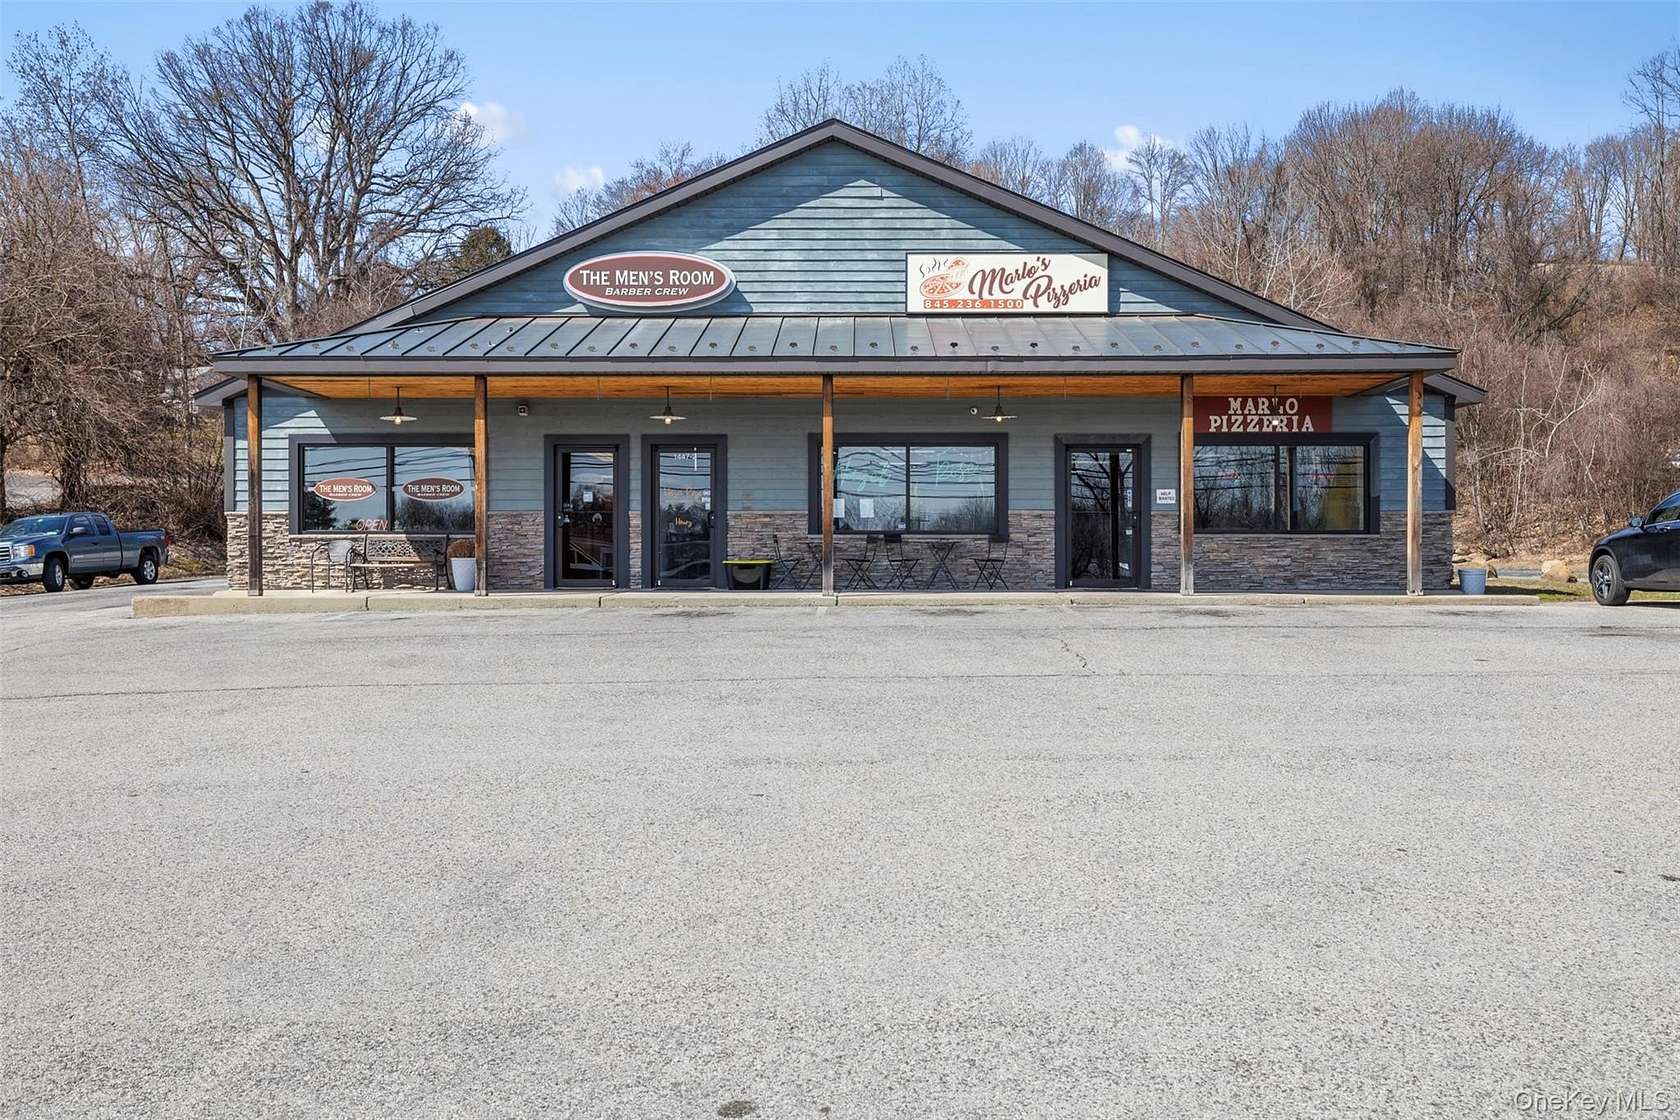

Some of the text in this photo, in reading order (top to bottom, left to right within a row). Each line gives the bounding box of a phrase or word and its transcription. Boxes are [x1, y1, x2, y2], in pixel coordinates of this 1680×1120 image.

[580, 270, 714, 285] THE MEN'S ROOM
[968, 256, 1051, 299] Marlo's
[605, 288, 689, 296] BARBER CREW
[1022, 273, 1101, 308] Pizzeria
[1209, 415, 1314, 432] PIZZERIA
[319, 484, 372, 493] THE MEN'S ROOM
[408, 484, 460, 493] THE MEN'S ROOM
[356, 519, 388, 531] OPEN
